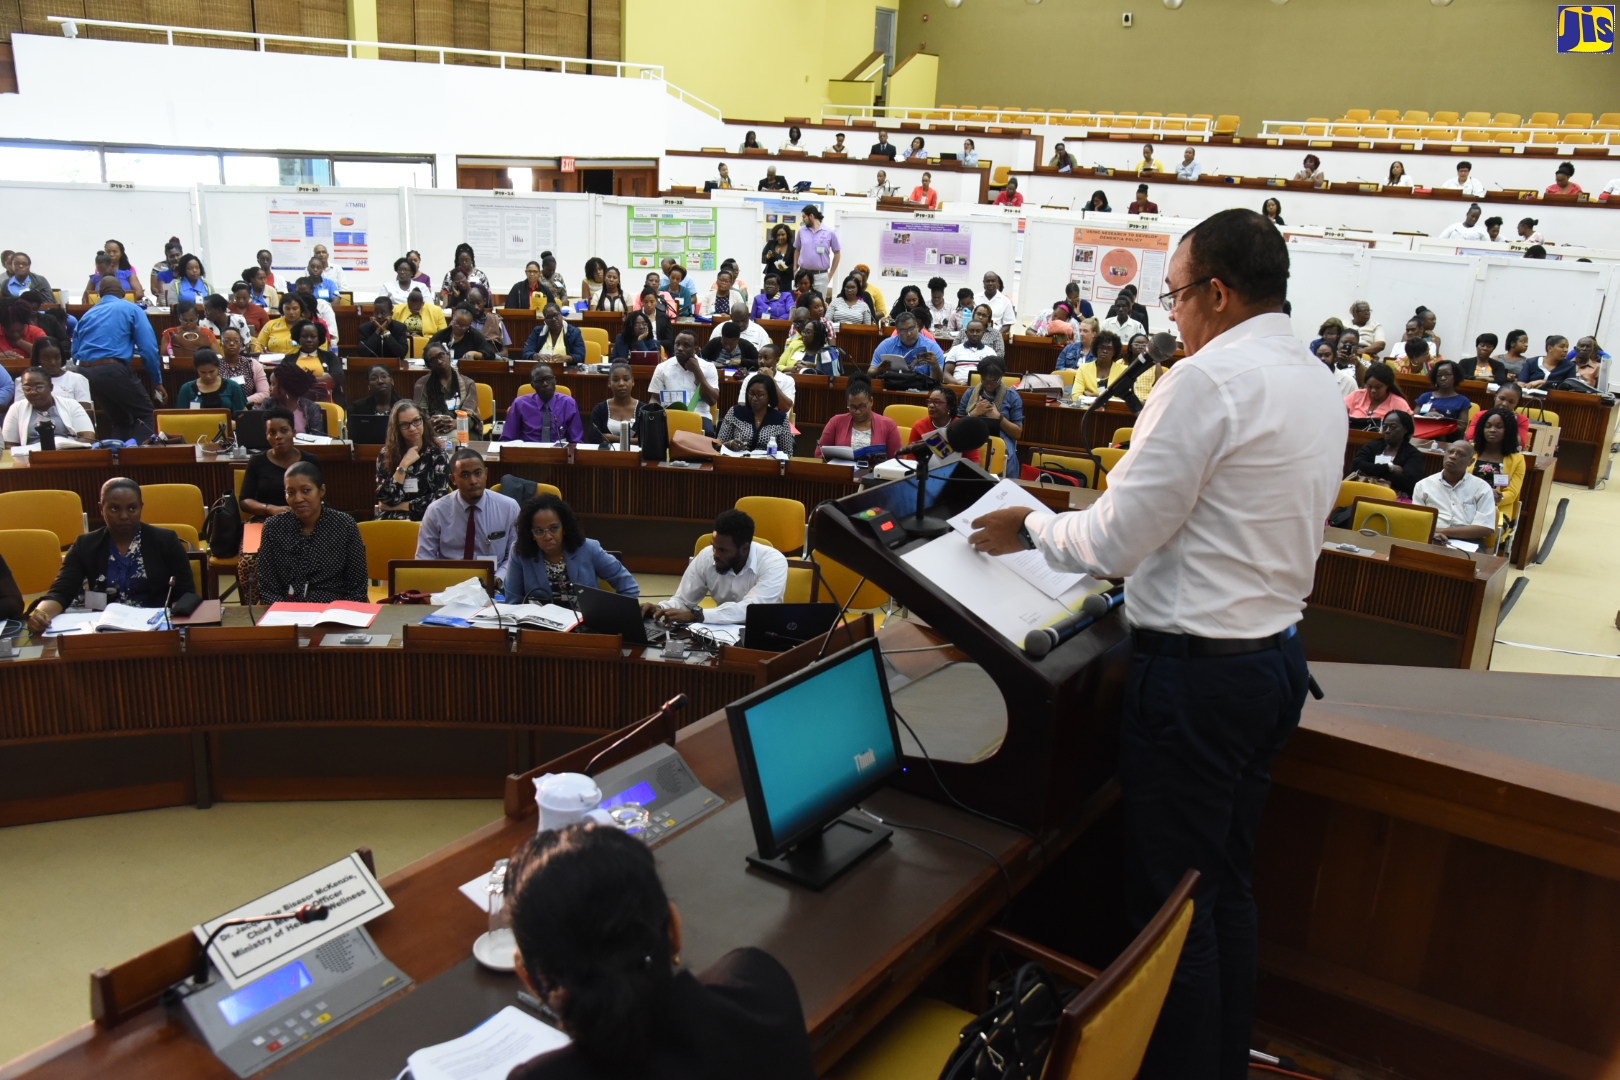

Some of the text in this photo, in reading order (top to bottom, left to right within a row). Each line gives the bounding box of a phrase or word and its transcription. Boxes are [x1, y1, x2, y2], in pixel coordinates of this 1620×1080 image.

[562, 158, 575, 171] EXIT
[220, 931, 234, 942] Dr.
[315, 874, 357, 895] McKenzie,
[231, 936, 273, 959] Ministry
[274, 928, 284, 938] of
[328, 889, 367, 910] Wellness
[247, 890, 343, 939] Chief Officer
